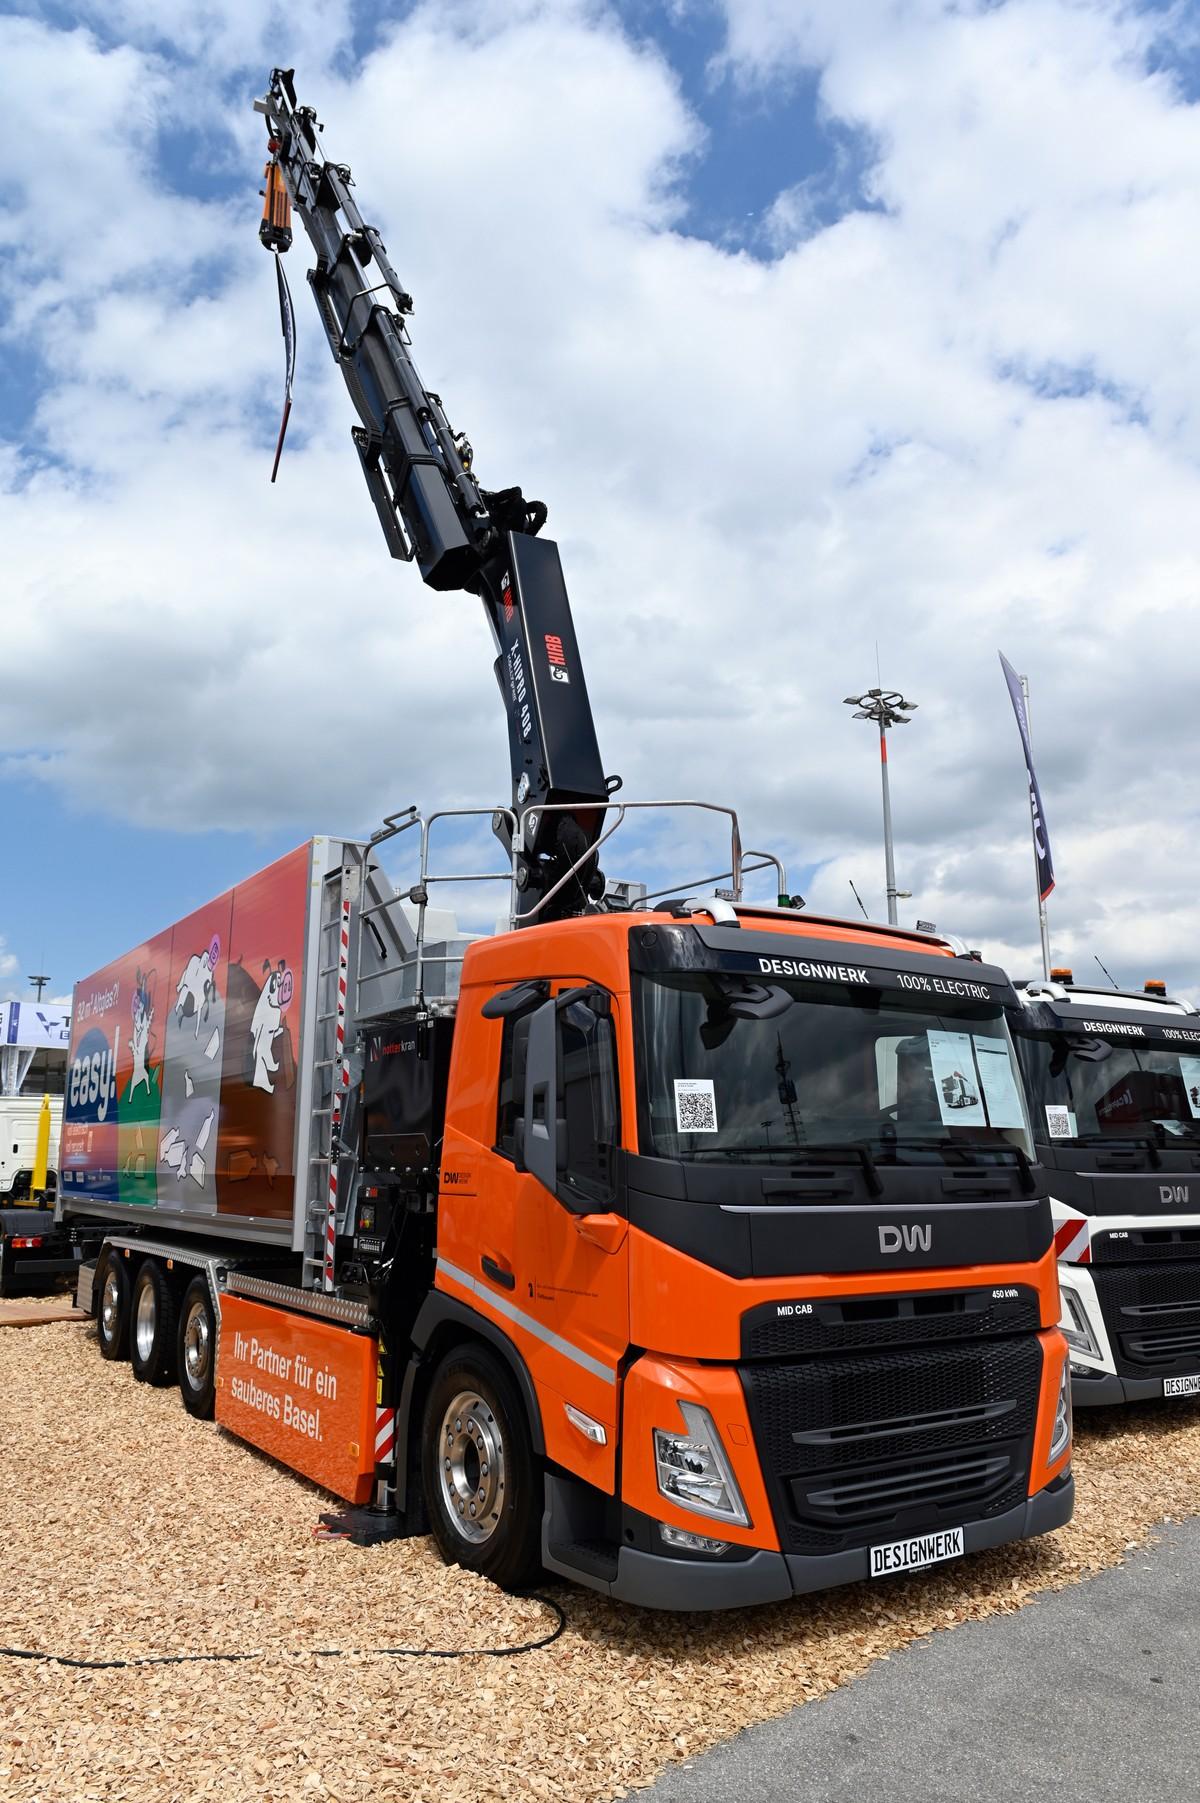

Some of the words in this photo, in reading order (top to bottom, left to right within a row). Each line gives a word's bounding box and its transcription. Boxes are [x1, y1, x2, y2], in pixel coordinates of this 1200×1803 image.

[544, 634, 566, 666] HIAB
[510, 638, 527, 703] X-HIPRO
[758, 957, 870, 984] DESIGNWERK
[896, 974, 932, 992] 100%
[933, 979, 991, 1000] ELECTRIC
[1082, 1021, 1146, 1037] DESIGNWERK
[1161, 1028, 1183, 1039] 100%
[70, 1025, 120, 1122] easy!
[443, 1171, 459, 1184] DW
[1159, 1185, 1189, 1204] DW
[878, 1224, 932, 1254] DW
[777, 1306, 794, 1316] MID
[795, 1304, 813, 1315] CAB
[992, 1290, 1004, 1298] 450
[234, 1331, 249, 1361] Ihr
[250, 1337, 292, 1380] Partner
[294, 1354, 313, 1389] für
[315, 1365, 337, 1401] ein
[231, 1376, 281, 1420] sauberes
[283, 1394, 323, 1442] Basel.
[874, 1530, 961, 1573] DESIGNWERK
